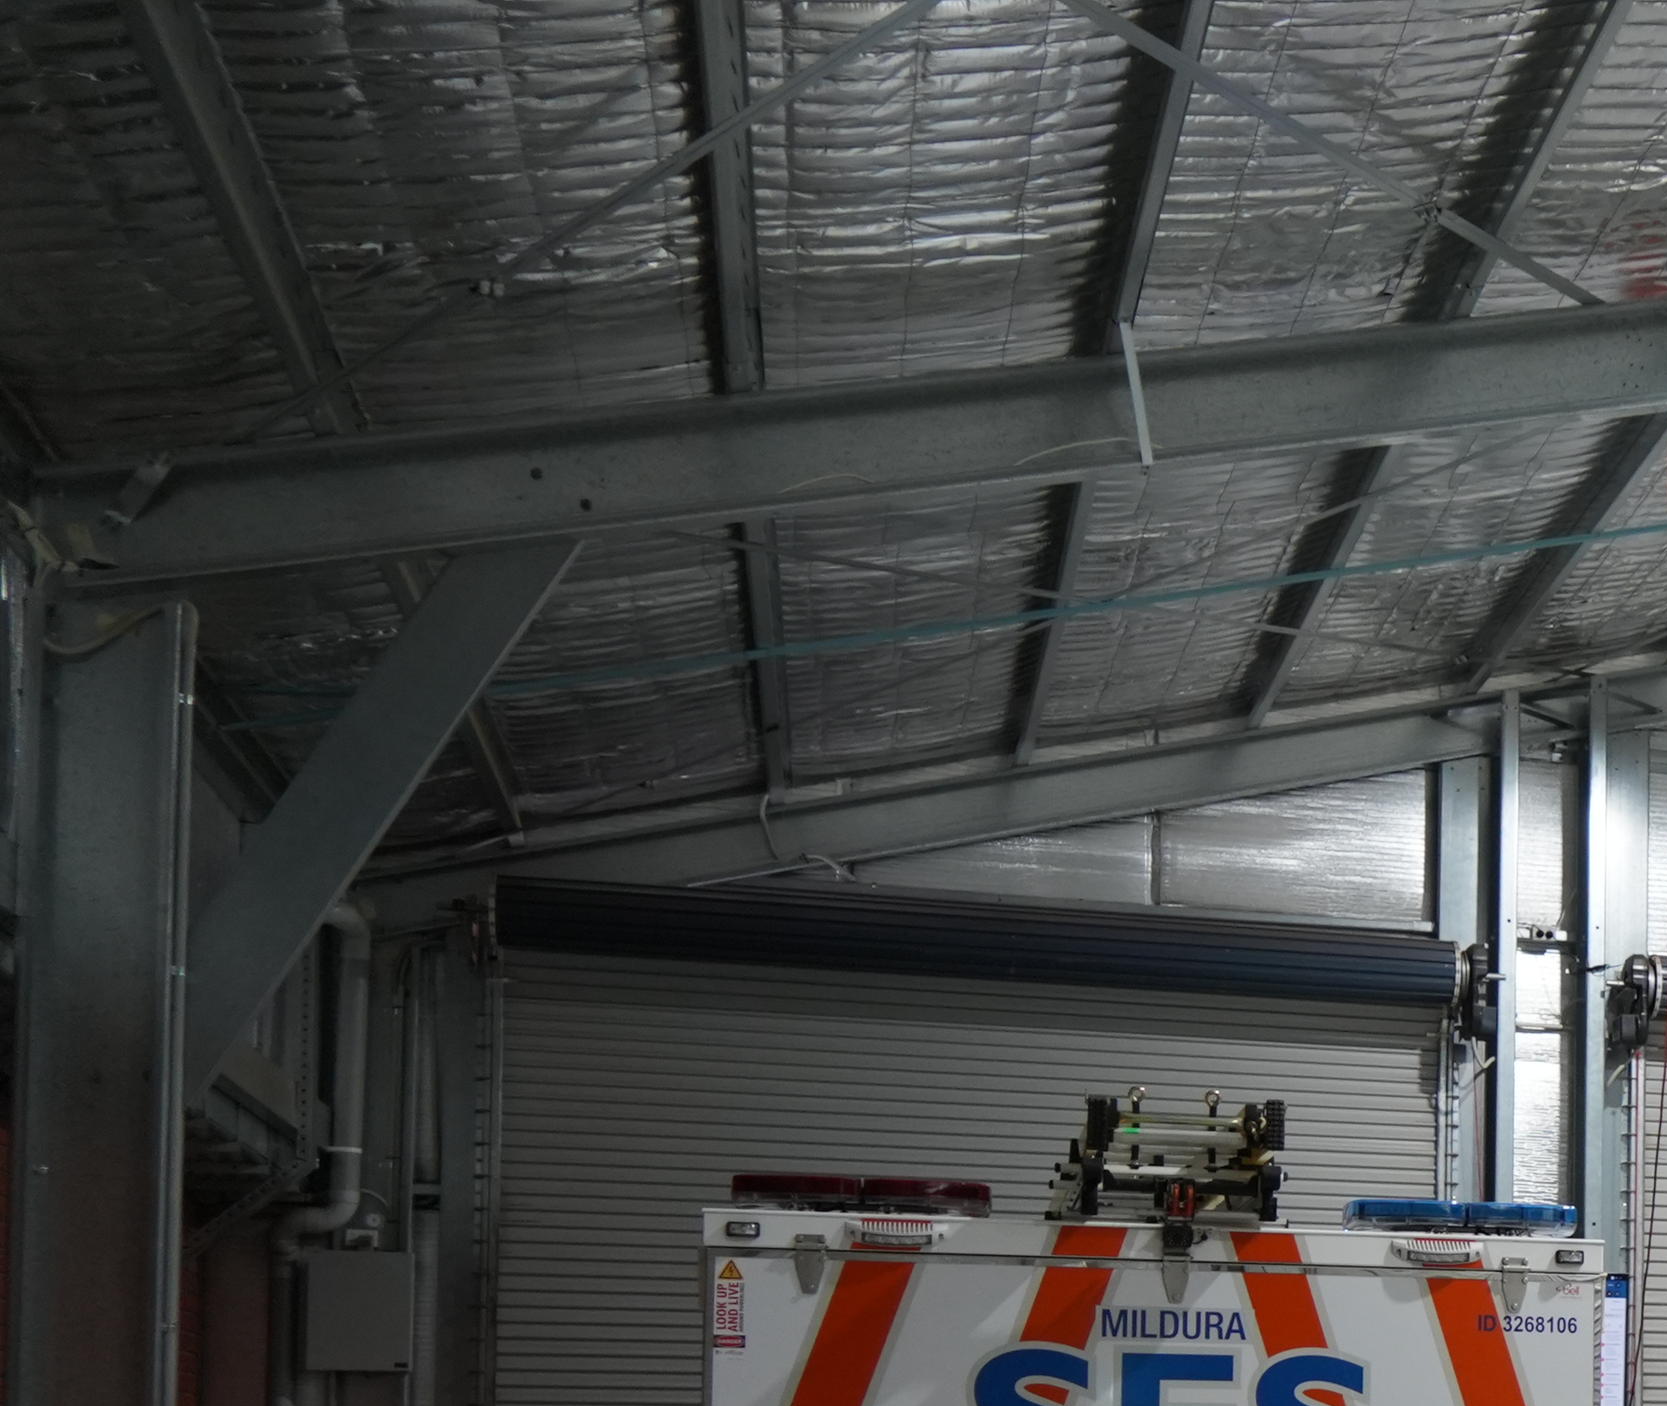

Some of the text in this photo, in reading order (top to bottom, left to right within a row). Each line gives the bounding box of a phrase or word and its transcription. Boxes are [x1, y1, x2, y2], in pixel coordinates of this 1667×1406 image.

[728, 1282, 739, 1306] LIVE
[716, 1283, 728, 1330] LOOK UP
[727, 1308, 739, 1332] AND
[1101, 1308, 1247, 1341] MILDURA
[1477, 1315, 1578, 1334] ID 3268106
